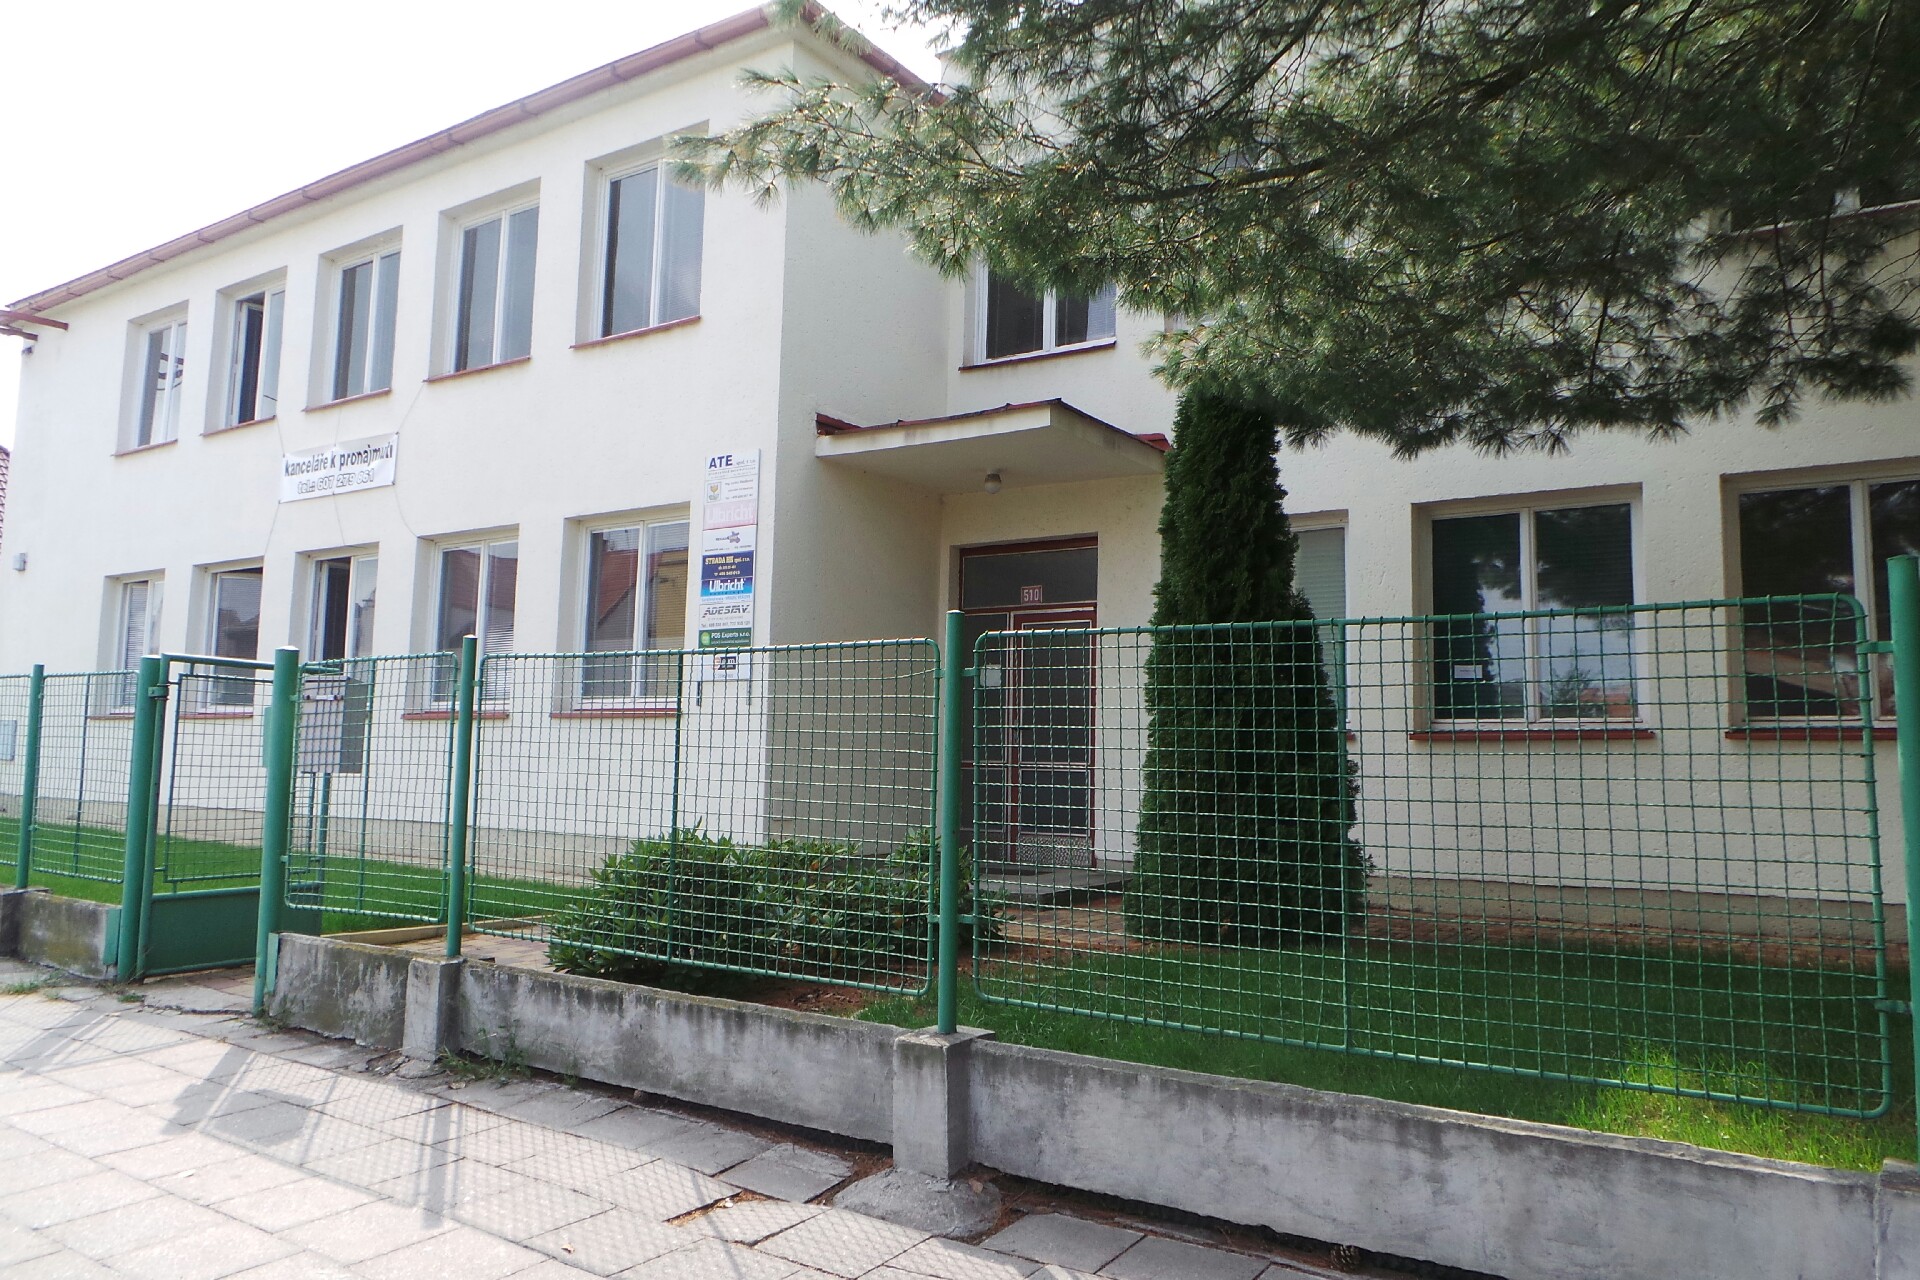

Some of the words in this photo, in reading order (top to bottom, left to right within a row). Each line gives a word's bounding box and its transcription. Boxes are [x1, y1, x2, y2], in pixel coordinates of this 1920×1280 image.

[285, 454, 328, 476] kanceláře
[330, 451, 336, 468] k
[709, 455, 733, 469] ATE
[317, 475, 335, 491] 607
[336, 472, 355, 488] 279
[705, 556, 726, 565] STRADA
[709, 578, 744, 592] Ulbricht
[1023, 589, 1039, 601] 510
